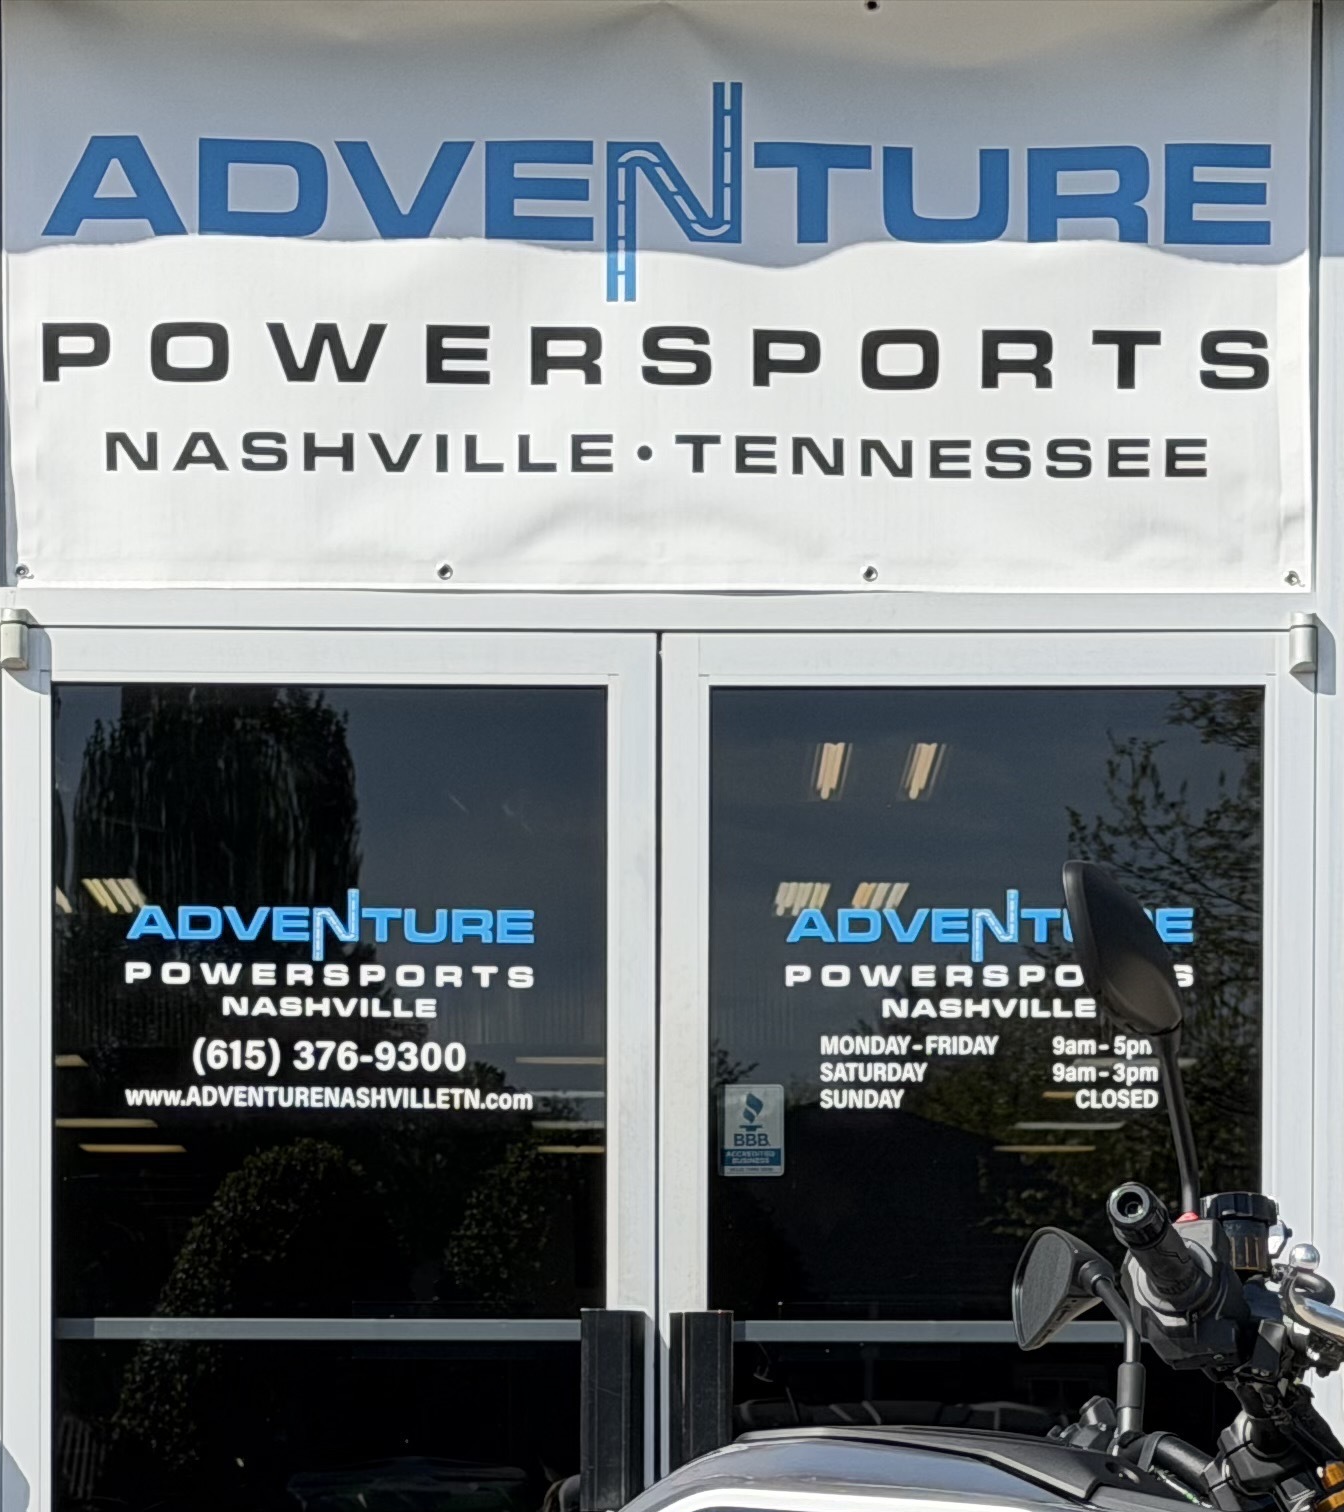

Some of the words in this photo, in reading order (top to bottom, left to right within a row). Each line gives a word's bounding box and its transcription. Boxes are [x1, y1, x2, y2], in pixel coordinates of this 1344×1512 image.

[40, 81, 1273, 303] ADVENTURE
[41, 320, 1271, 390] POWERSPORTS
[104, 430, 616, 475] NASHVILLE
[674, 433, 1210, 479] TENNESSEE
[126, 888, 535, 962] ADVENTURE
[785, 889, 1195, 962] ADVENTE
[124, 962, 535, 988] POWERSPORTS
[784, 964, 1194, 988] POWERSPOS
[221, 996, 437, 1018] NASHVILLE
[881, 998, 1097, 1019] NASHVILLE
[192, 1037, 281, 1076] (615)
[292, 1041, 467, 1072] 376-9300
[819, 1062, 928, 1083] SATURDAY
[125, 1087, 534, 1111] www.ADVENTURENASHVILLETN.com
[819, 1089, 904, 1110] SUNDAY
[1075, 1088, 1159, 1109] CLOSED
[733, 1133, 770, 1147] BBB
